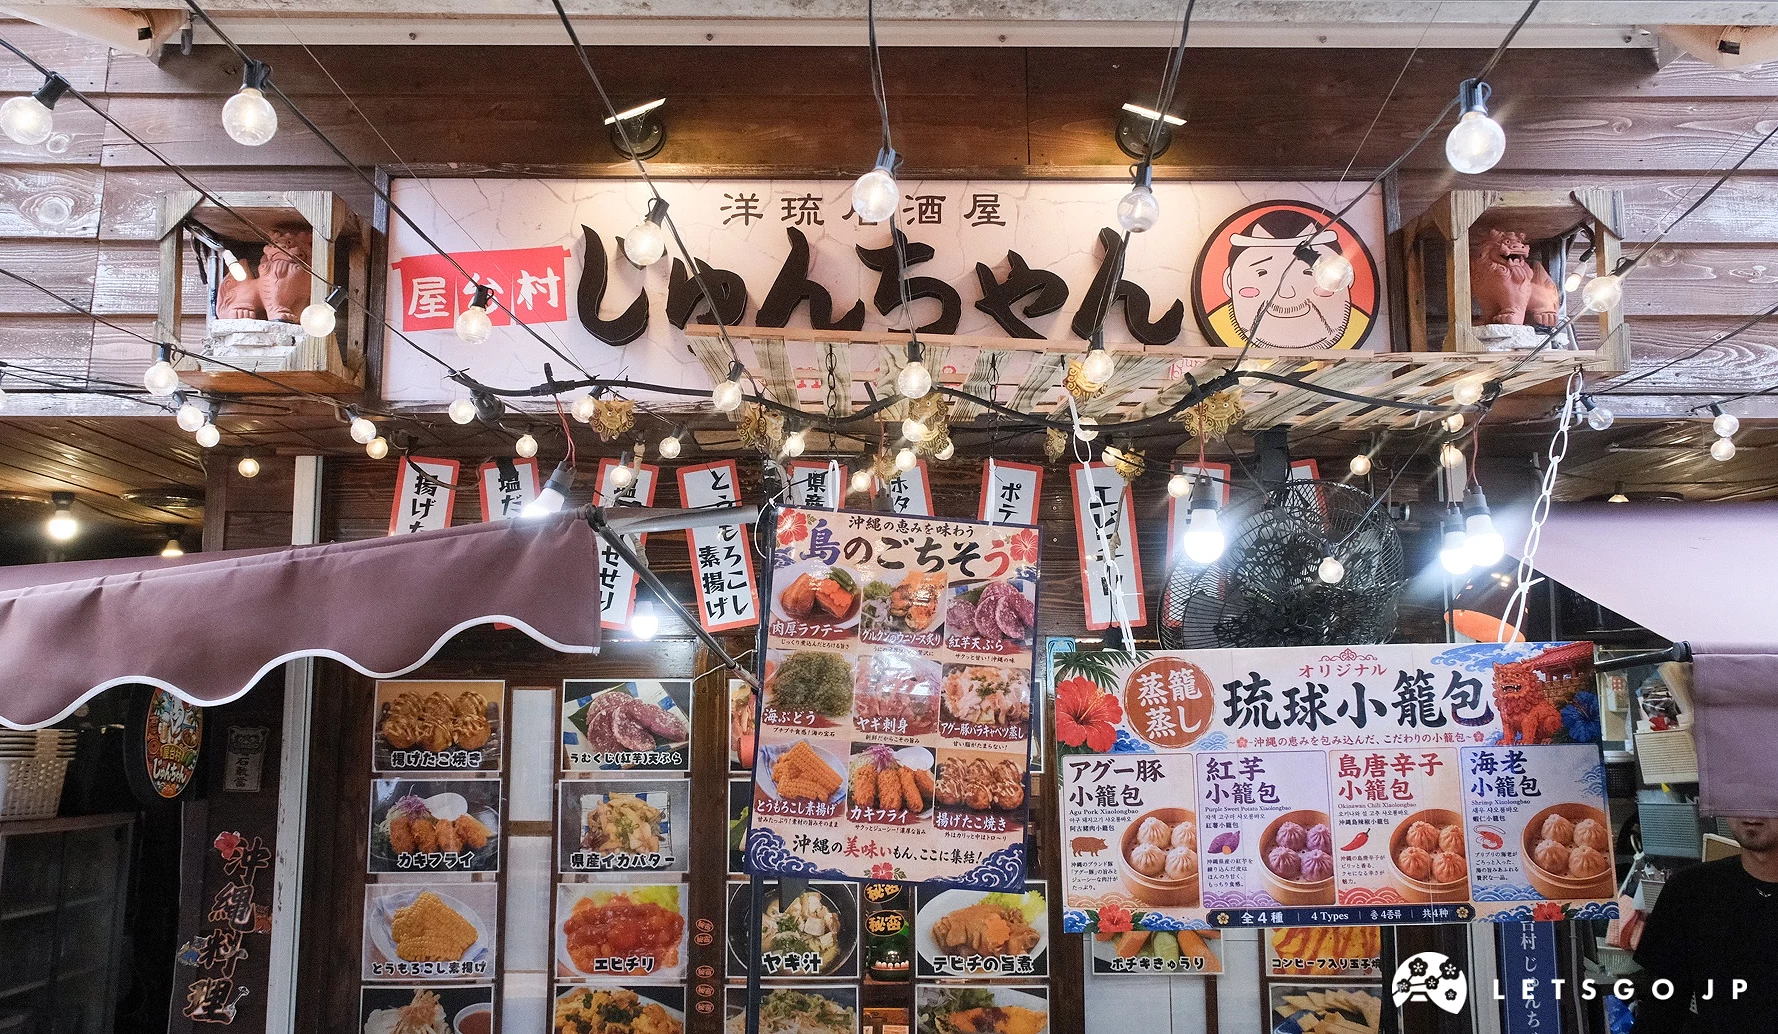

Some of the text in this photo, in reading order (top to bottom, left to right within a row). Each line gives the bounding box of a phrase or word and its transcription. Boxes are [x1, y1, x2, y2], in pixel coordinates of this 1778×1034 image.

[576, 224, 1184, 346] じゅんちゃん
[849, 516, 974, 538] 沖縄の恵みを味わう
[800, 518, 1010, 577] 島のごちそう
[699, 545, 727, 620] 素揚げ
[772, 621, 843, 637] 肉厚ラフテー
[948, 635, 1004, 652] 紅芋天ぷら
[1299, 663, 1388, 679] オリジナル
[1136, 668, 1203, 707] 蒸籠
[1222, 668, 1495, 732] 琉球小籠包
[763, 708, 816, 726] 海ぶどう
[857, 717, 908, 734] ヤギ刺身
[1145, 705, 1202, 739] 蒸し
[941, 722, 1024, 741] アグー豚バラキャベツ蒸し
[391, 751, 482, 769] 揚げたこ焼き
[1206, 756, 1266, 782] 紅芋
[1338, 753, 1444, 779] 島唐辛子
[1470, 750, 1528, 776] 海老
[1069, 758, 1166, 784] アグー豚
[1069, 784, 1144, 808] 小籠包
[1205, 782, 1280, 805] 小籠包
[1338, 779, 1414, 801] 小籠包
[1471, 776, 1542, 798] 小籠包
[757, 800, 837, 817] とうもろこし素揚げ
[850, 805, 909, 824] カキフライ
[936, 811, 1007, 832] 揚げたこ焼き
[397, 851, 475, 869] カキフライ
[570, 853, 675, 870] 県産イカバター
[868, 914, 902, 931] 秘密
[1241, 911, 1284, 924] 全4種
[1311, 911, 1349, 921] 4 Types
[371, 960, 487, 976] とうもろこし素揚げ
[594, 956, 655, 973] エビチリ
[762, 951, 822, 974] ヤギ汁
[932, 953, 1035, 974] テビチの旨煮
